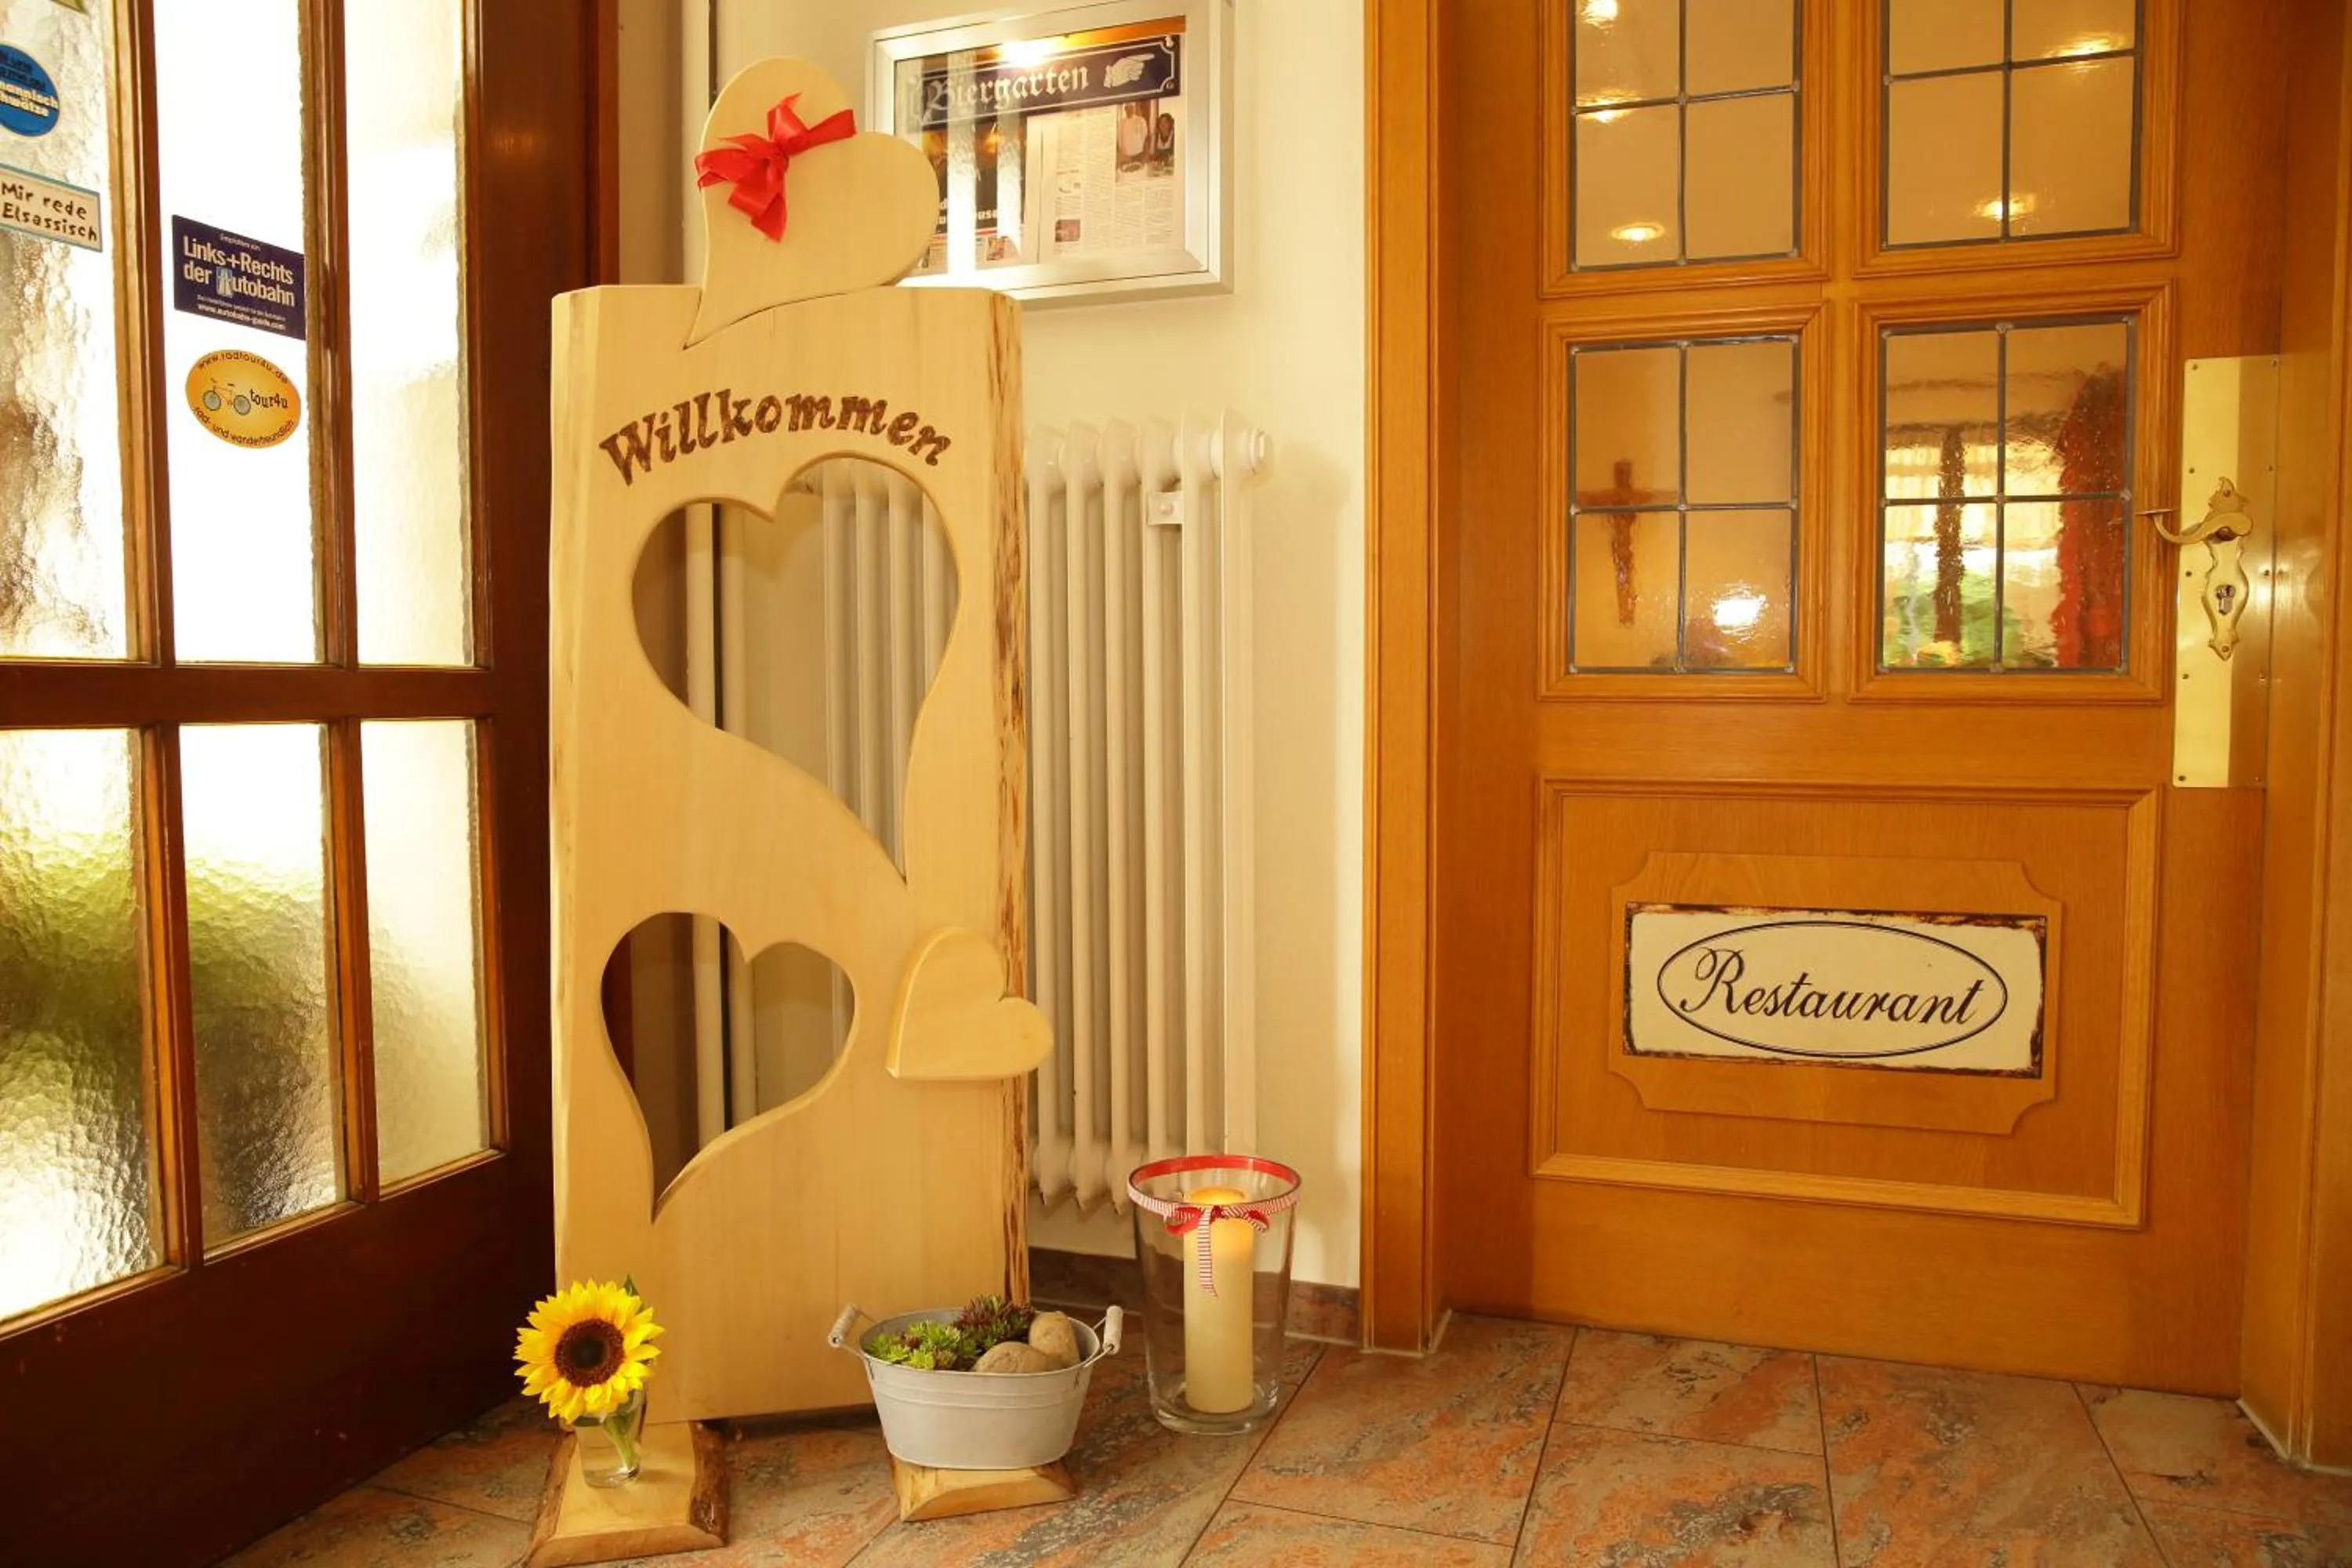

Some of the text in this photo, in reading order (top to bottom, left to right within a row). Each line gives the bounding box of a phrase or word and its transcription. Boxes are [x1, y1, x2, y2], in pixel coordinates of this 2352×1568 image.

[927, 66, 1090, 111] Biergarten
[2, 183, 87, 220] Mir rede
[2, 202, 98, 241] Elsassisch
[183, 234, 294, 285] Links+Rechts
[183, 260, 212, 285] der
[250, 388, 289, 409] tour4u
[212, 424, 230, 438] und
[599, 388, 952, 487] Willkommen
[1679, 946, 1985, 1025] Restaurant
